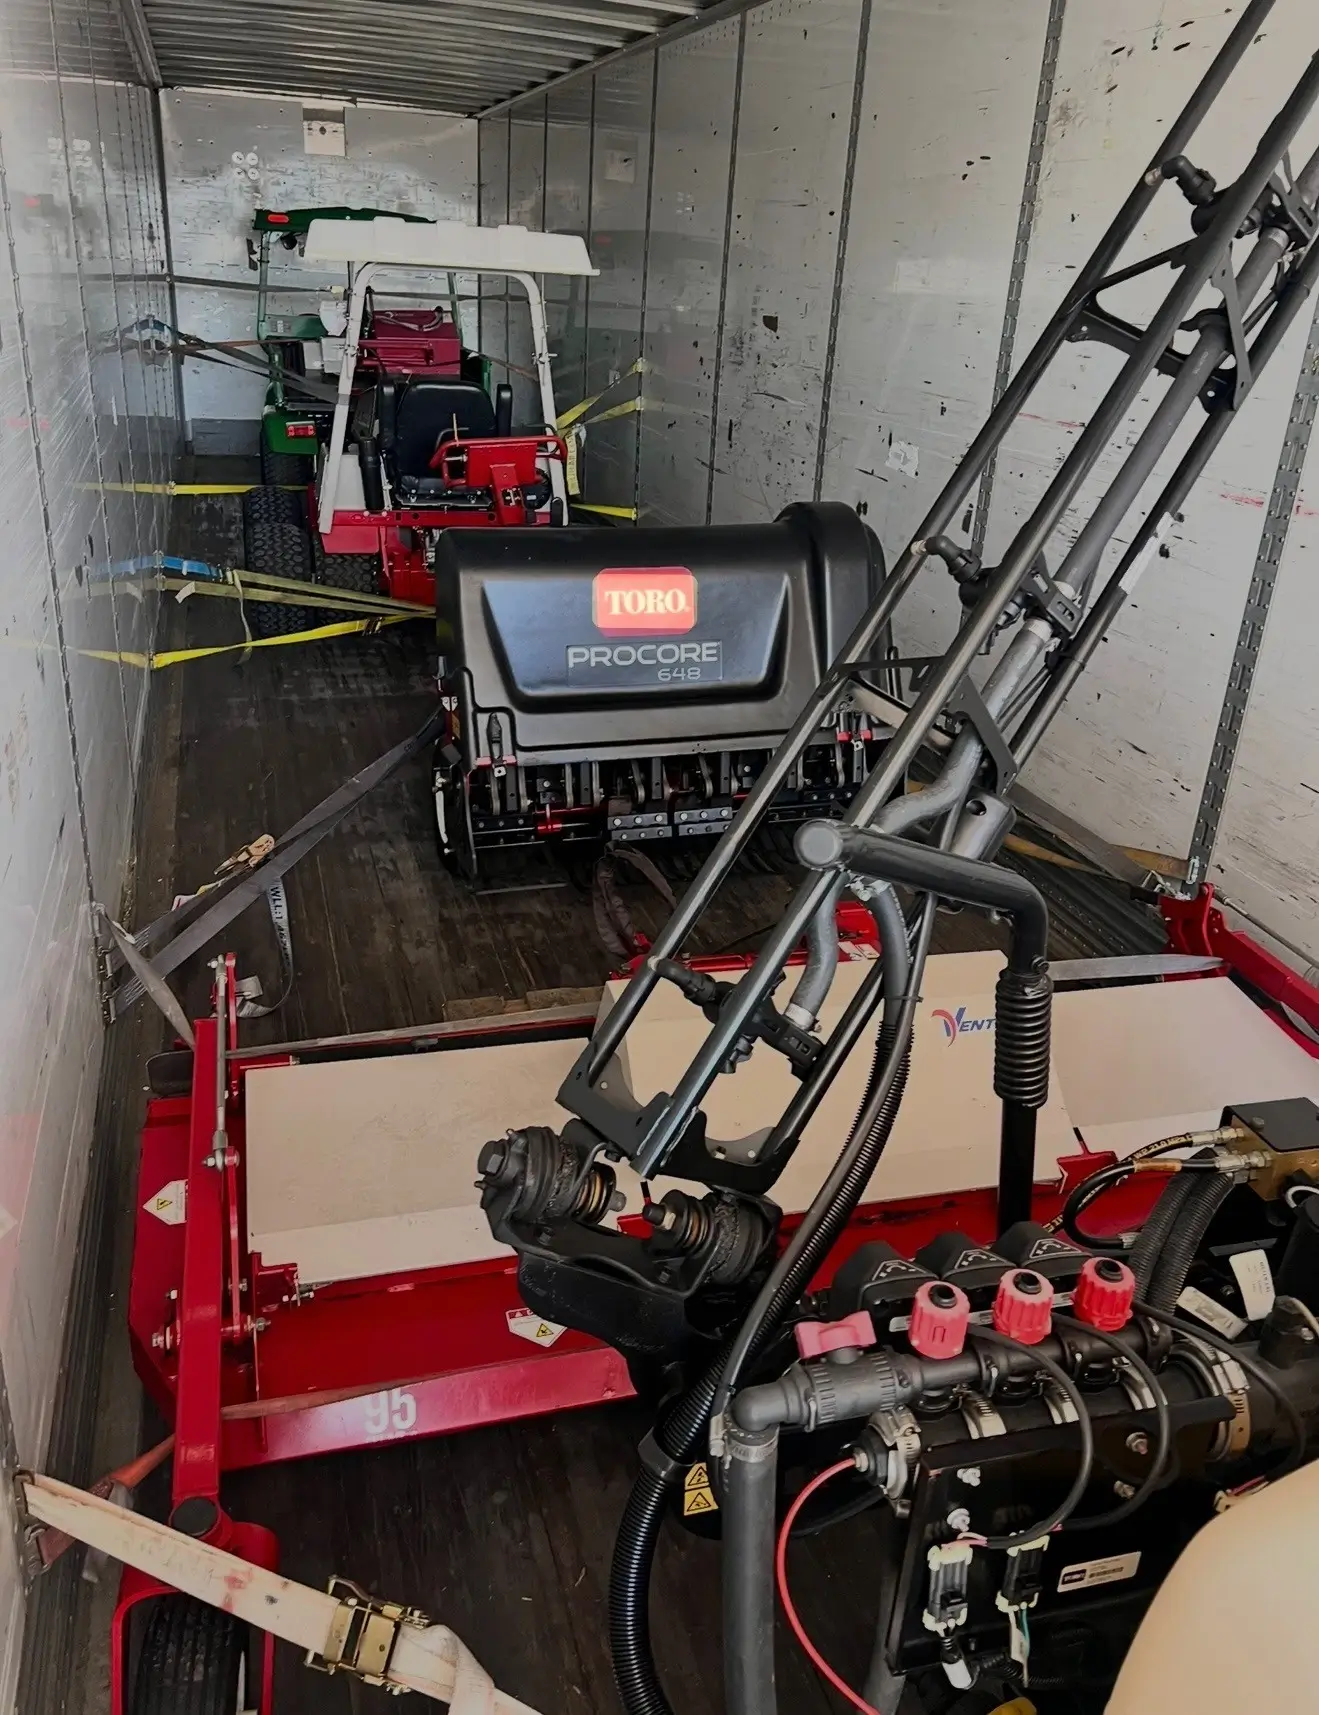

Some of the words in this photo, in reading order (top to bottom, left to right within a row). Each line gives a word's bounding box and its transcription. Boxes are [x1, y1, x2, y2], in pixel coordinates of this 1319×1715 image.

[567, 641, 718, 669] PROCORE
[657, 666, 702, 682] 648
[931, 1007, 997, 1047] VENT
[364, 1386, 417, 1435] 95
